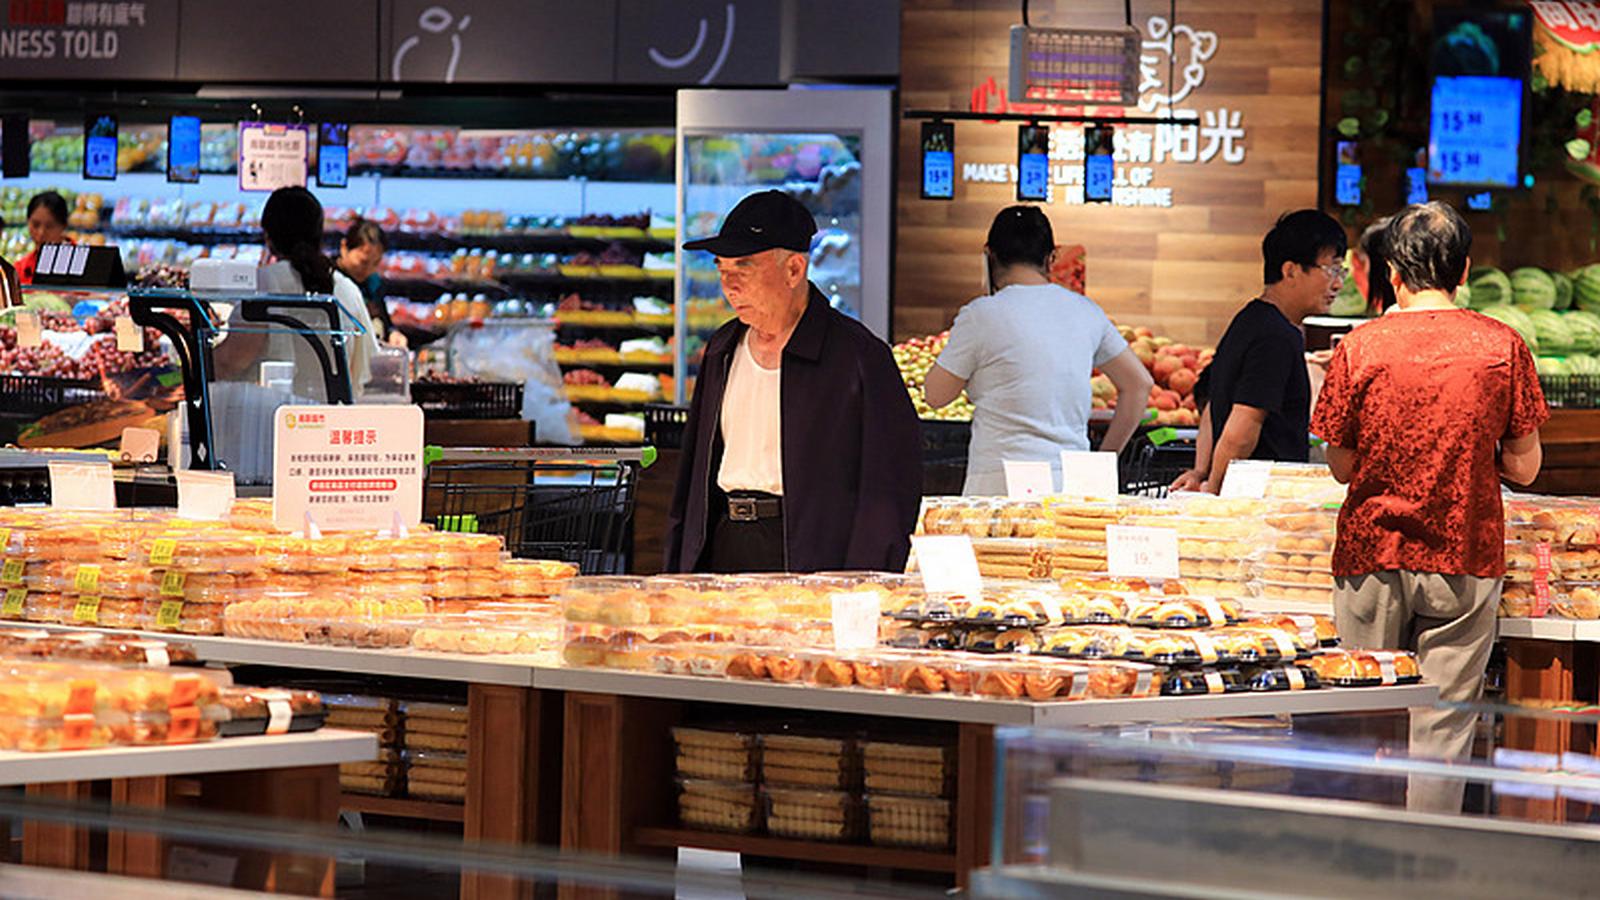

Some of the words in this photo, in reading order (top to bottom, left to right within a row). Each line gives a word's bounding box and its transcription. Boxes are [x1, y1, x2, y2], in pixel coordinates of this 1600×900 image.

[0, 30, 56, 58] NESS
[62, 30, 118, 58] TOLD
[963, 163, 1008, 183] MAKE
[1130, 167, 1153, 187] OF
[330, 430, 377, 445] 温馨提示
